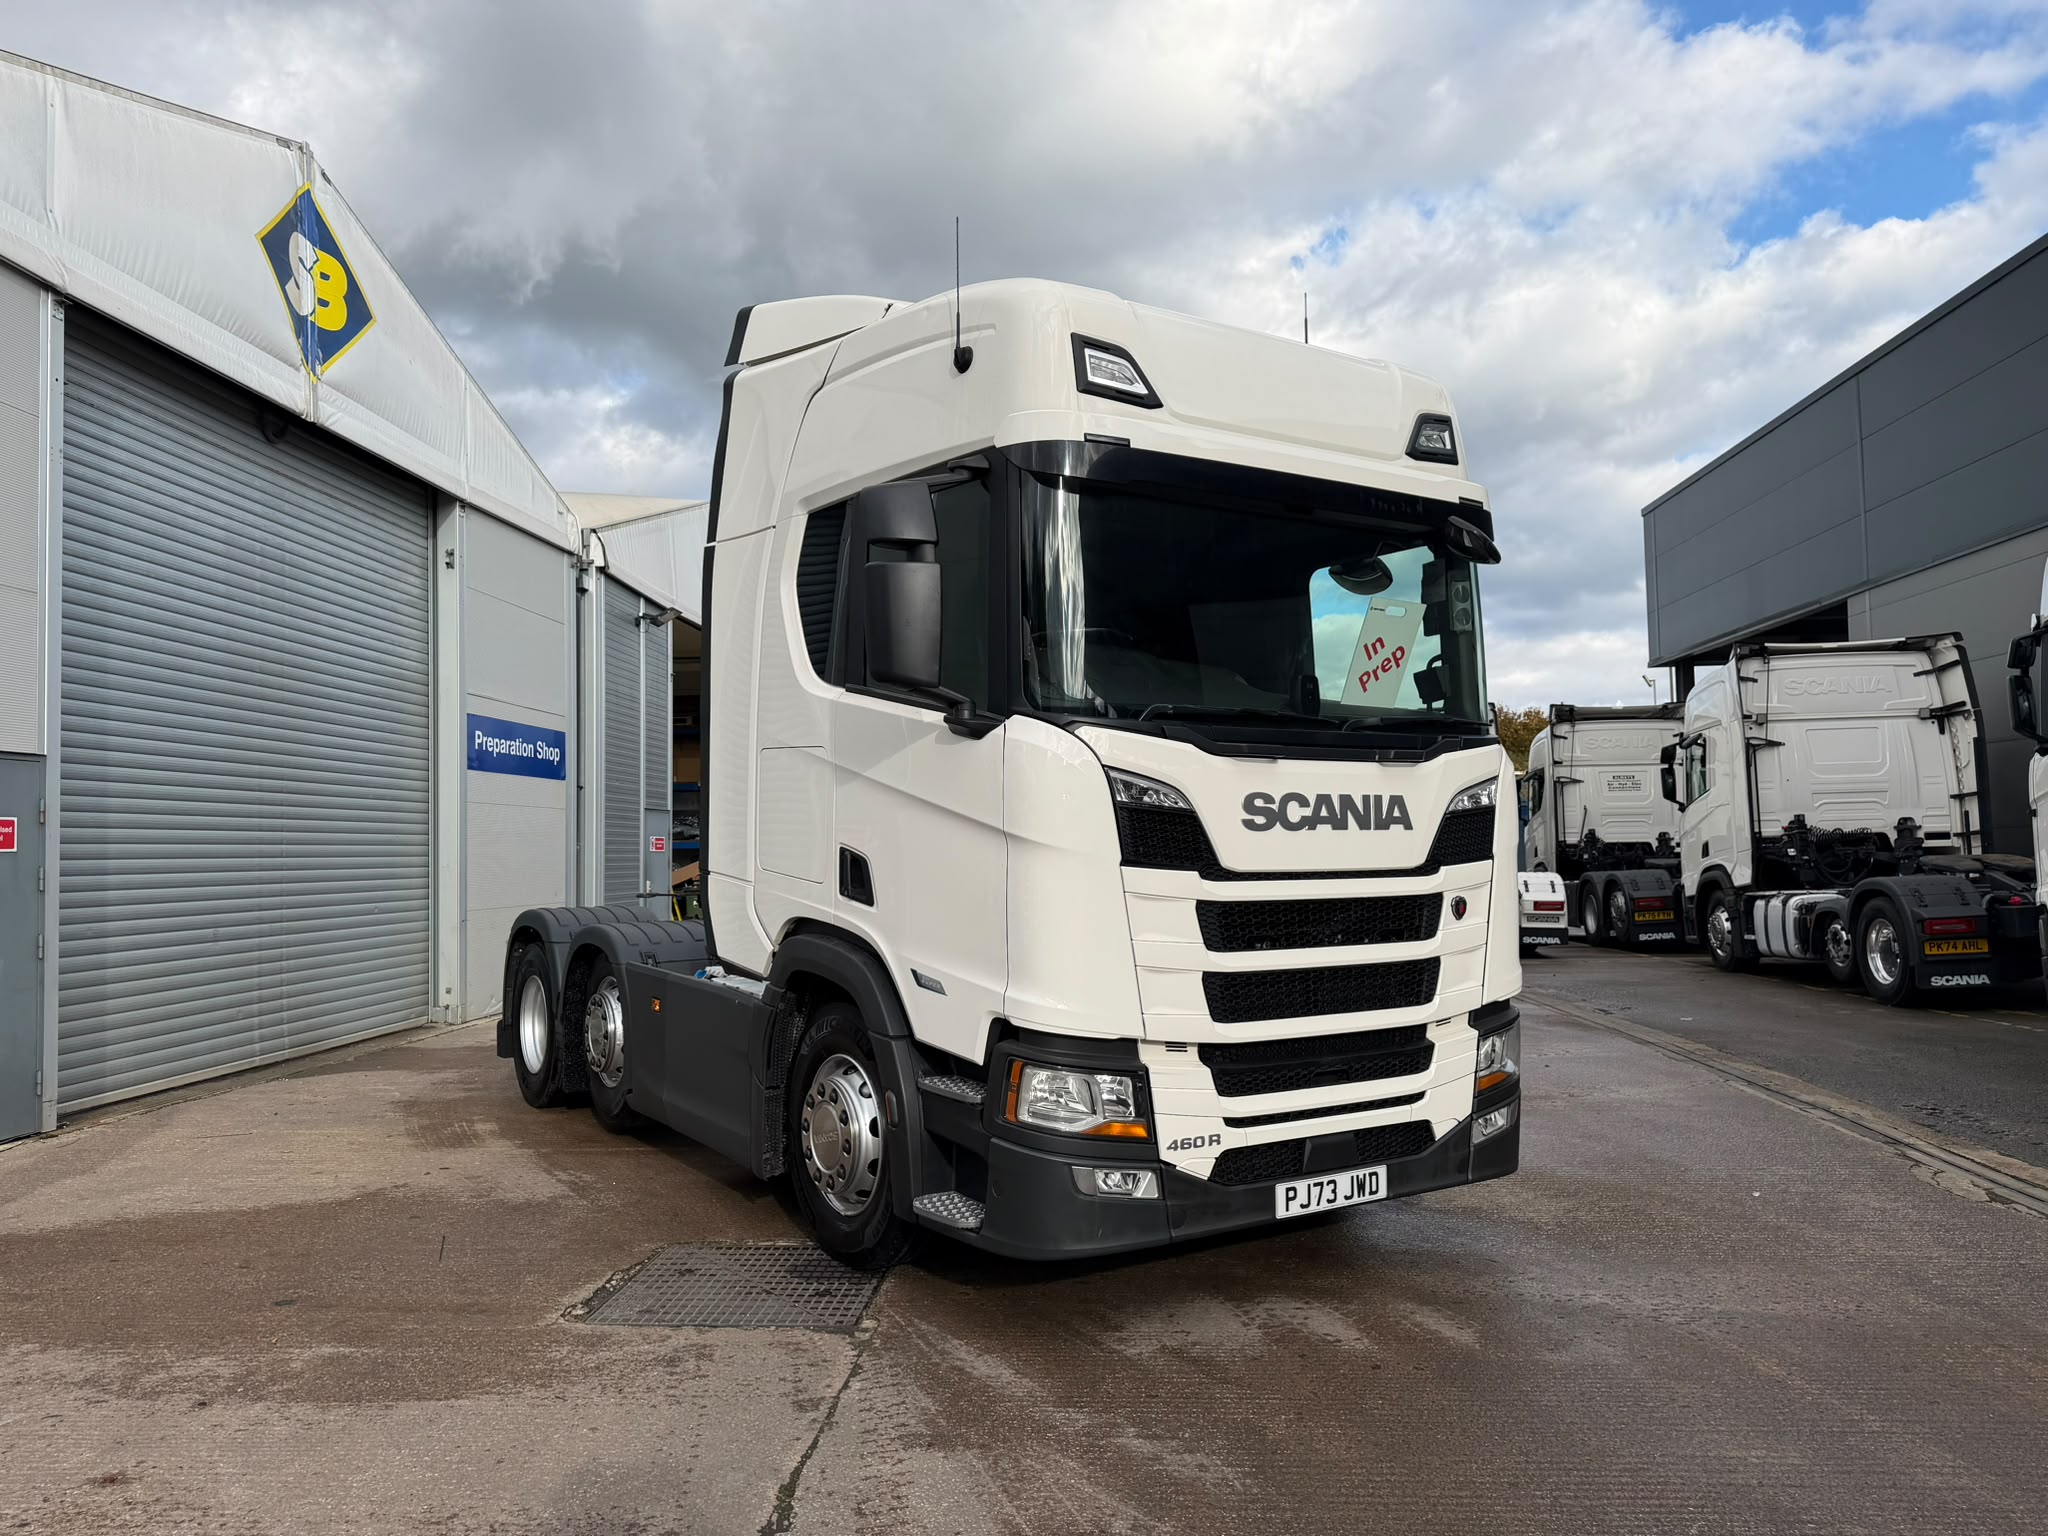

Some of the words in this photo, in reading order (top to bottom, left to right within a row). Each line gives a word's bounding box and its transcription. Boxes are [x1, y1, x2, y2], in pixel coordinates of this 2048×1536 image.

[1363, 637, 1386, 661] In
[1358, 645, 1406, 693] Prep
[1783, 677, 1893, 697] SCANIA
[475, 730, 534, 757] Preparation
[536, 740, 560, 765] Shop
[1241, 791, 1413, 831] SCANIA
[1522, 936, 1561, 944] SCANIA
[1639, 932, 1676, 941] SCANIA
[1929, 941, 1958, 952] PK74
[1962, 940, 1983, 951] AHL
[1930, 974, 1990, 986] SCANIA
[1166, 1136, 1206, 1151] 460
[1208, 1133, 1221, 1146] R
[1285, 1179, 1337, 1213] PJ73
[1343, 1170, 1380, 1200] JWD
